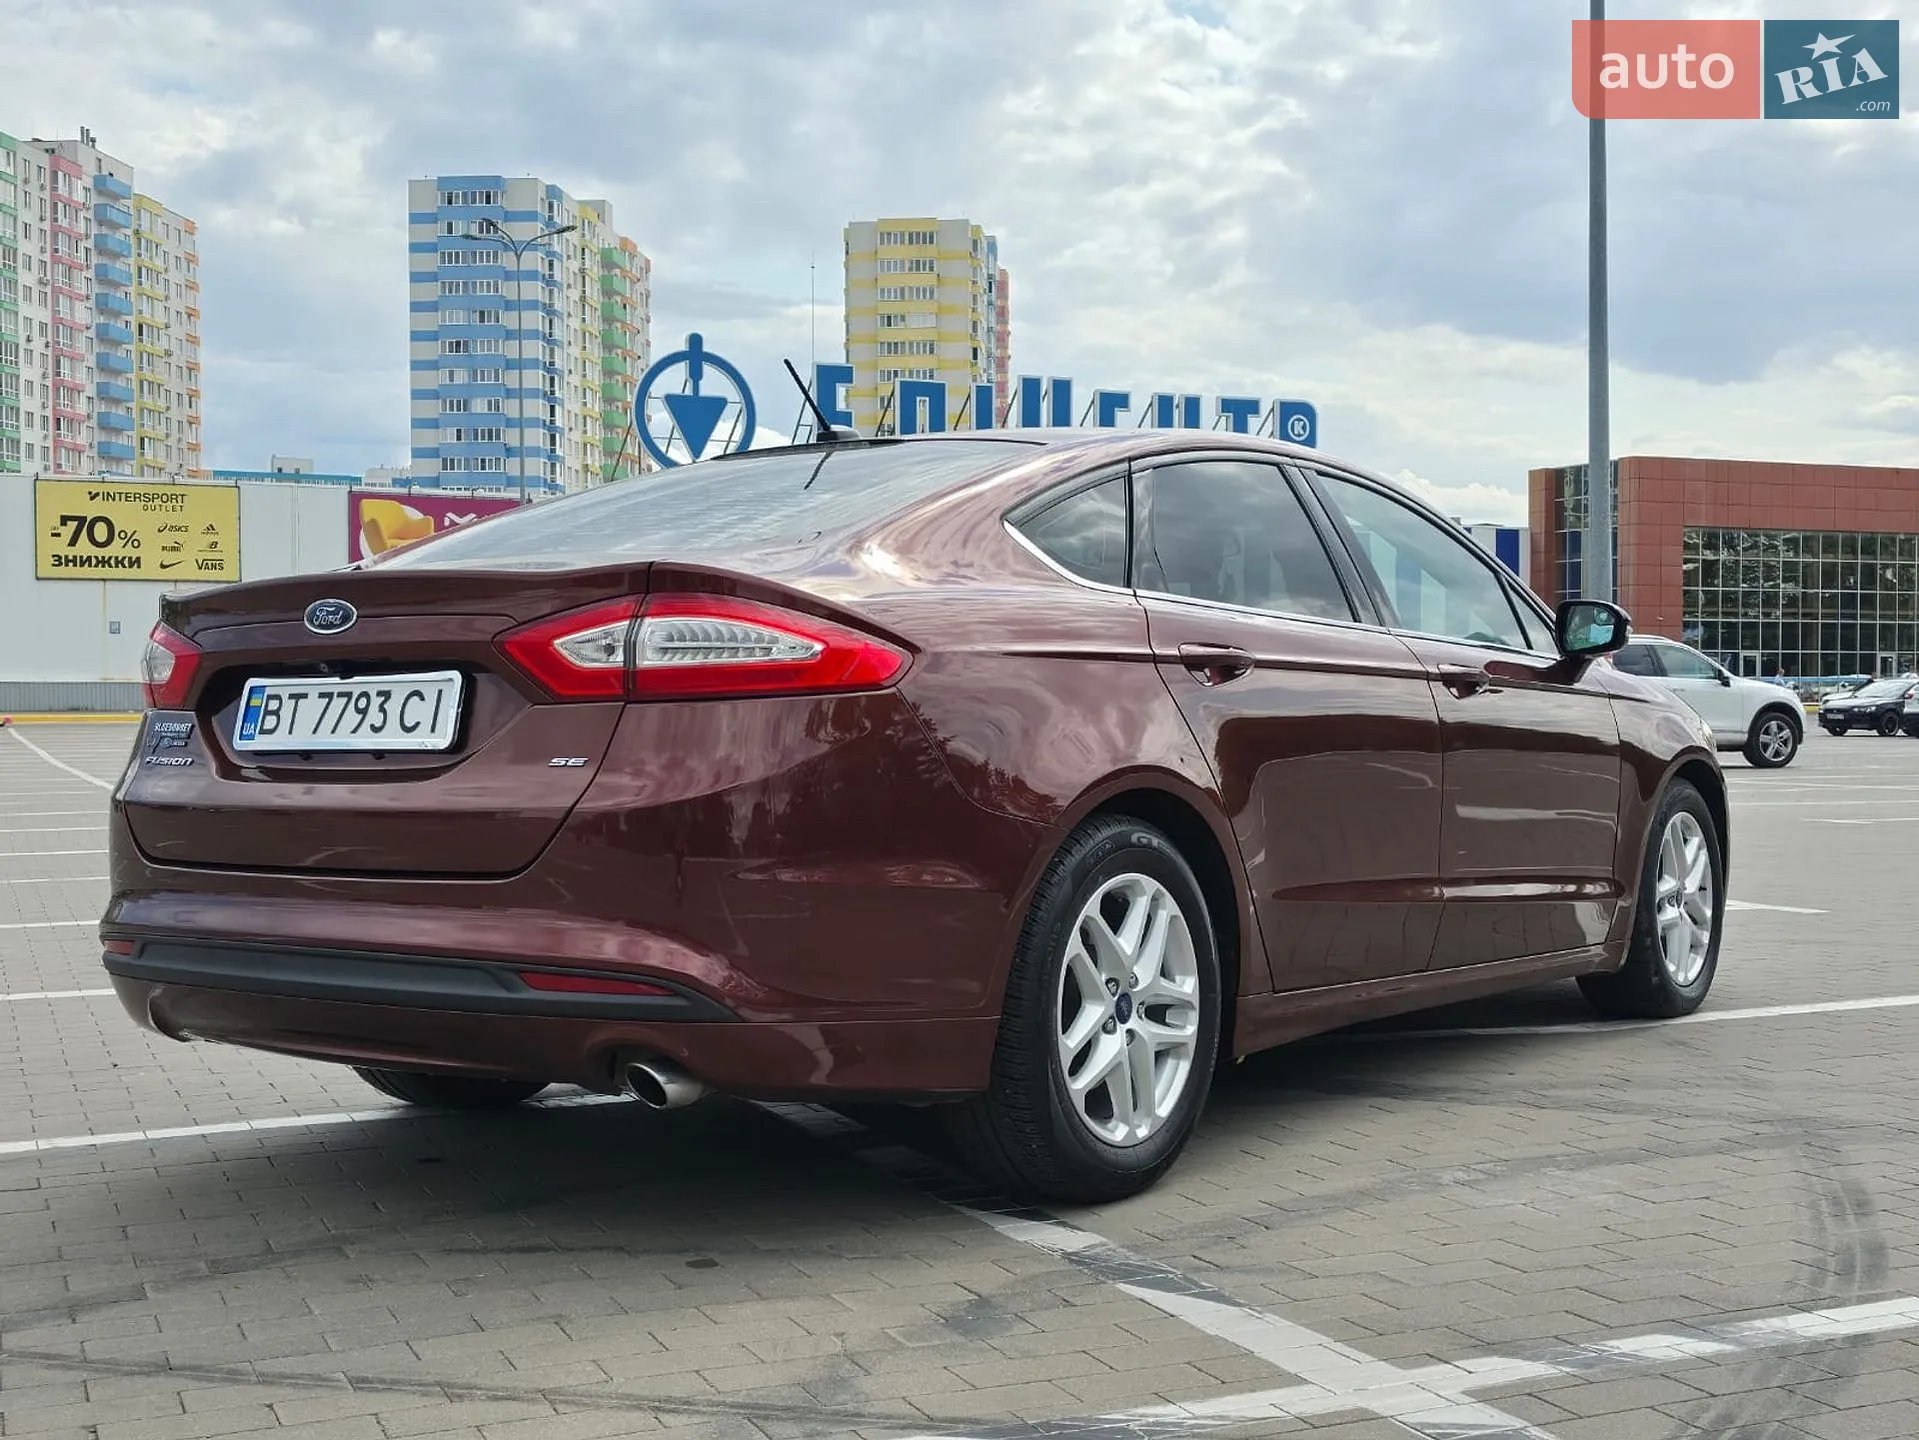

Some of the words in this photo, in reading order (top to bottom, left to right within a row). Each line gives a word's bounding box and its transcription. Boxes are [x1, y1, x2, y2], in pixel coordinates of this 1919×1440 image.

[101, 491, 188, 504] INTERSPORT
[142, 504, 184, 512] OUTLET
[51, 554, 142, 569] ЗНИЖКИ
[313, 606, 344, 626] Ford
[257, 692, 309, 735] BT
[312, 689, 393, 735] 7793
[399, 689, 444, 734] CI
[242, 722, 257, 735] UA
[145, 756, 193, 766] FUSION
[548, 757, 589, 767] SE
